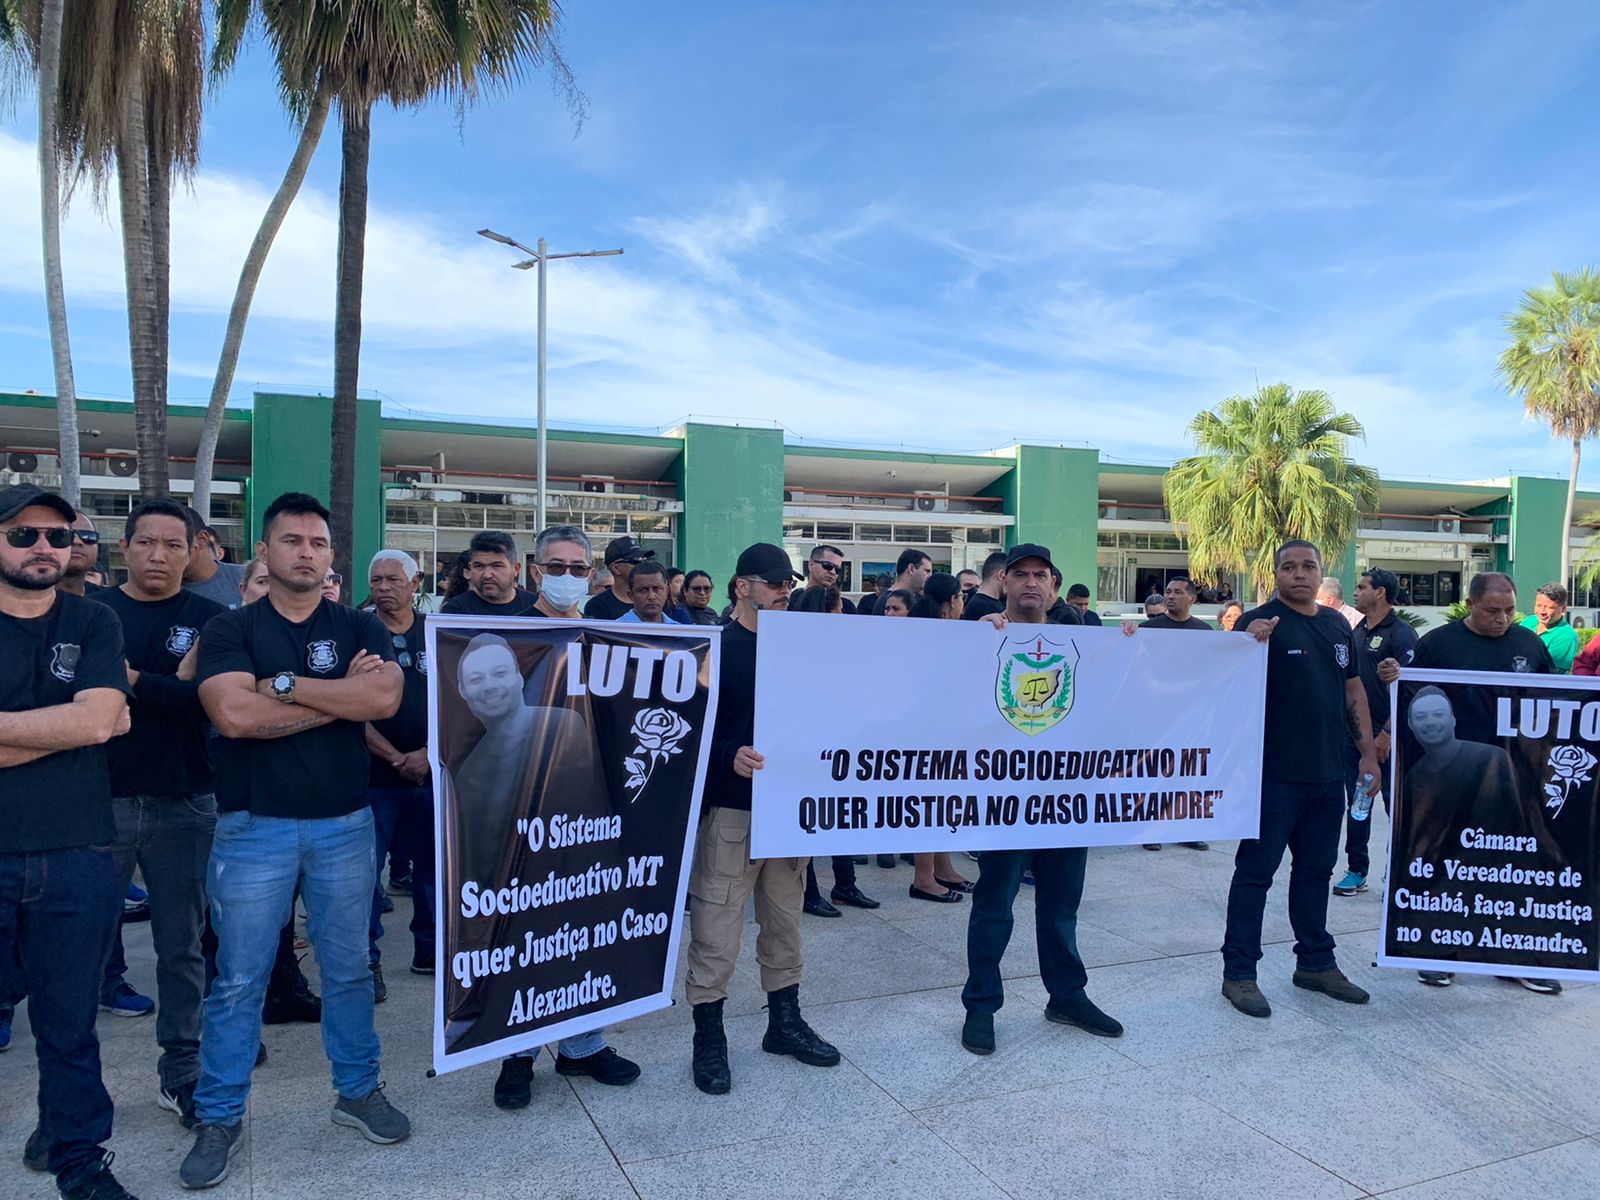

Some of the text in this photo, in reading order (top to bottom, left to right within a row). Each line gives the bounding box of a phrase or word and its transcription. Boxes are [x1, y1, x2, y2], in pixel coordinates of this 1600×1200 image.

[567, 642, 697, 702] LUTO
[1497, 697, 1600, 741] LUTO
[856, 750, 968, 781] SISTEMA
[974, 748, 1175, 781] SOCIOEDUCATIVO
[1179, 747, 1210, 776] MT
[549, 814, 621, 848] Sistema
[799, 797, 867, 833] QUER
[874, 795, 979, 833] JUSTIÇA
[985, 795, 1019, 826] NO
[1025, 794, 1087, 825] CASO
[1461, 828, 1537, 852] Câmara
[460, 856, 663, 918] Socioeducativo MT
[1409, 857, 1581, 888] de Vereadores de
[1395, 888, 1592, 925] Cuiabá, faça Justiça
[453, 907, 667, 988] quer Justiça no Caso
[1397, 926, 1588, 954] no caso Alexandre.
[507, 969, 616, 1027] Alexandre.
